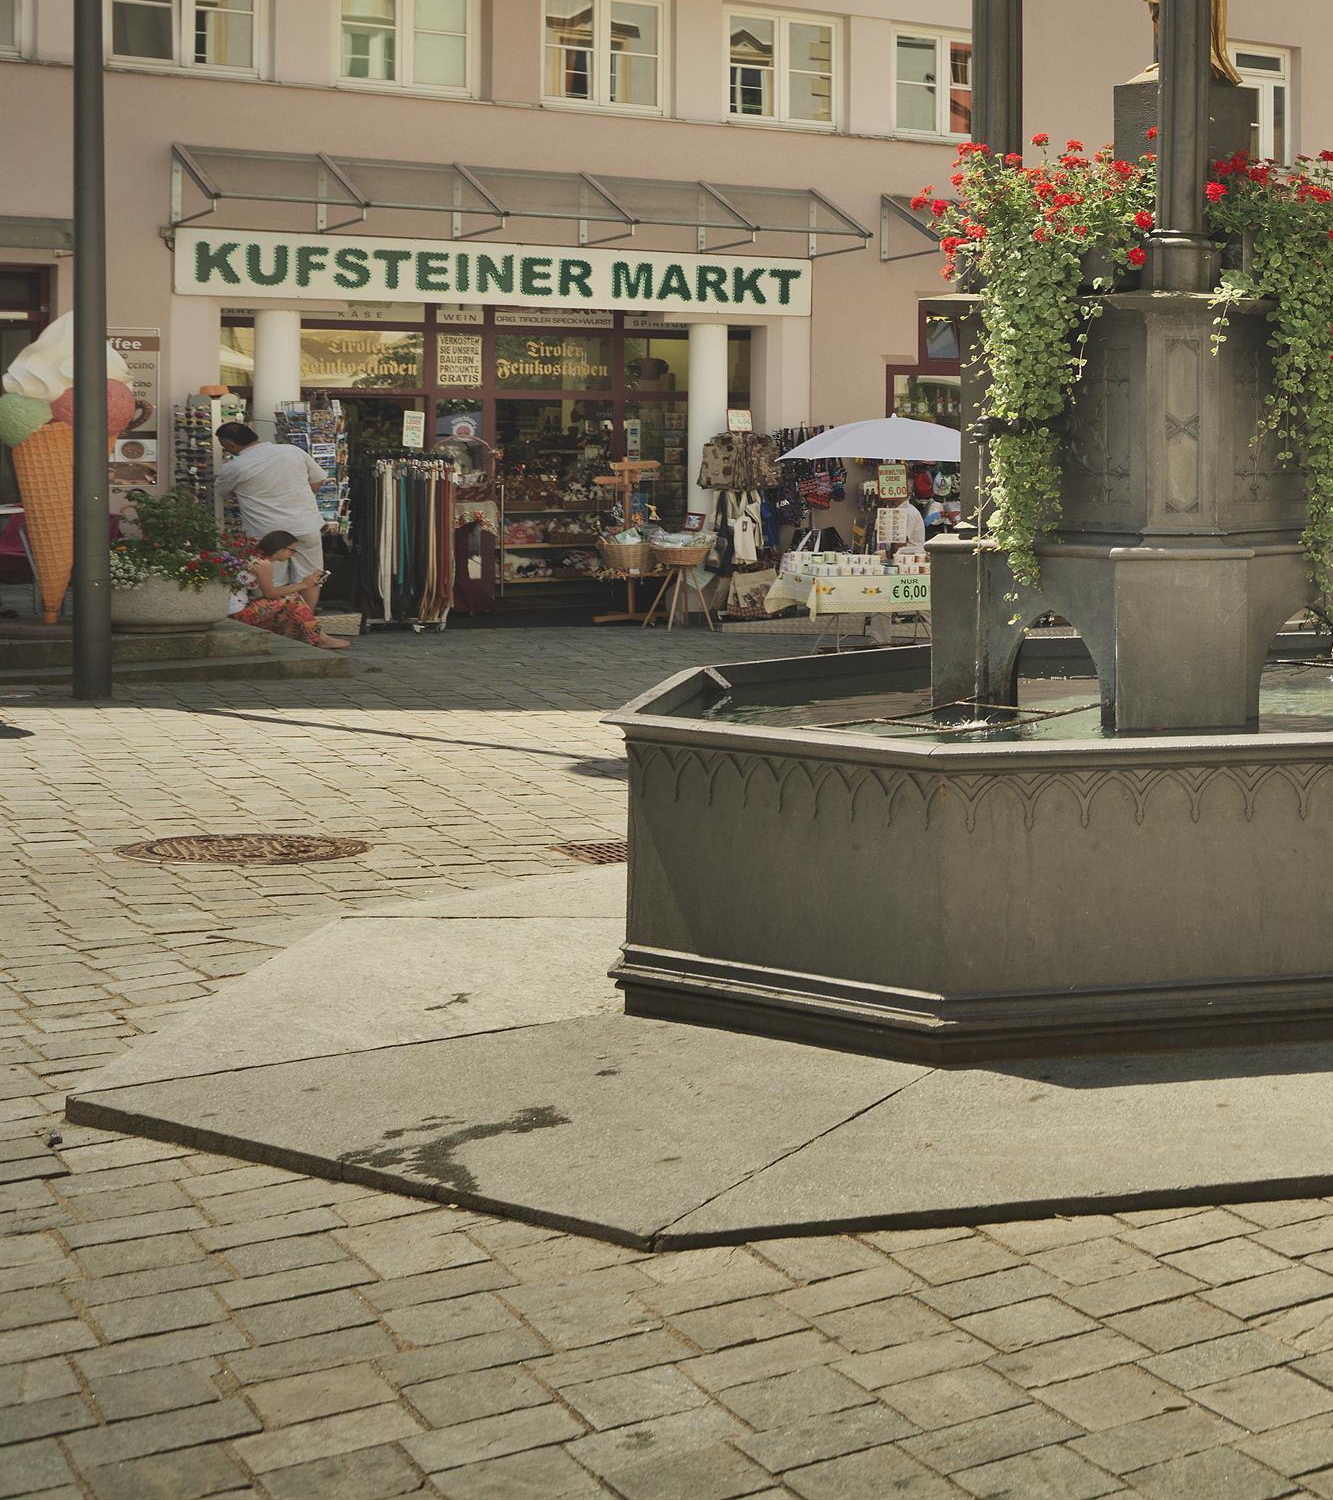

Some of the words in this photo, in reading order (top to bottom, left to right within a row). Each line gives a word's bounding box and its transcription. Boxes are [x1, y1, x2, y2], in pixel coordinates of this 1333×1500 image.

[195, 241, 593, 298] KUFSTEINER
[611, 261, 802, 305] MARKT
[443, 313, 477, 322] WEIN
[519, 316, 551, 324] TIROLER
[108, 338, 142, 350] ffee
[440, 336, 480, 346] VERKOSTEN
[440, 346, 452, 355] SIE
[453, 346, 480, 356] UNSERE
[527, 341, 584, 357] Tiroler
[440, 365, 480, 374] PRODUKTE
[496, 359, 608, 379] Feinkostladen
[440, 374, 479, 383] GRATIS
[888, 486, 907, 497] 6,00
[892, 585, 900, 598] €
[903, 585, 927, 600] 6,00
